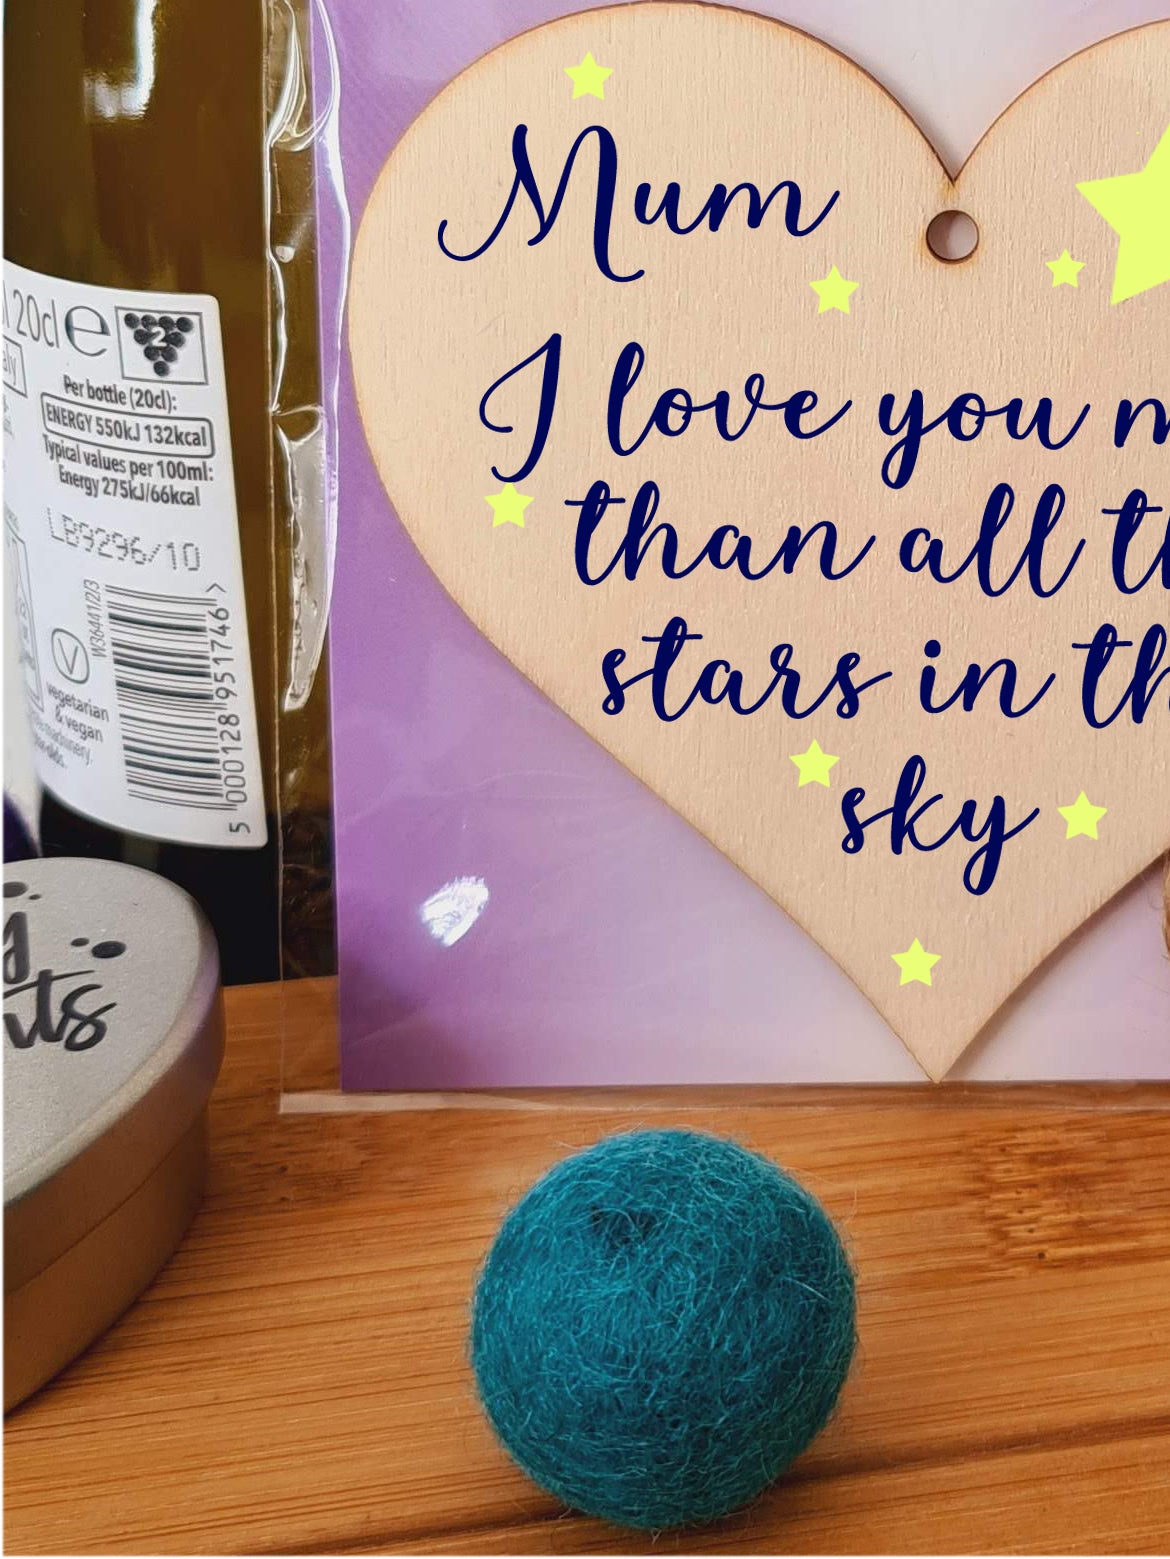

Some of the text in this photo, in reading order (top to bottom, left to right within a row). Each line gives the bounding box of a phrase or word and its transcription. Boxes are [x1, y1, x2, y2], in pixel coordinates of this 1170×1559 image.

[438, 125, 840, 283] Mum
[13, 289, 60, 349] 20cl
[63, 374, 178, 415] Per bottle (20cl):
[480, 333, 562, 483] I
[608, 342, 853, 457] love
[878, 390, 1091, 490] you
[46, 402, 208, 448] ENERGY 550kJ 132kcal
[43, 433, 215, 482] Typical values per 100ml:
[58, 464, 202, 508] Energy 275kJ/66kcal
[564, 480, 876, 586] than
[899, 484, 1086, 598] all
[602, 617, 893, 722] stars
[919, 639, 1056, 719] in
[46, 682, 110, 723] vegetarian
[65, 715, 104, 743] vegan
[841, 756, 1040, 896] sky
